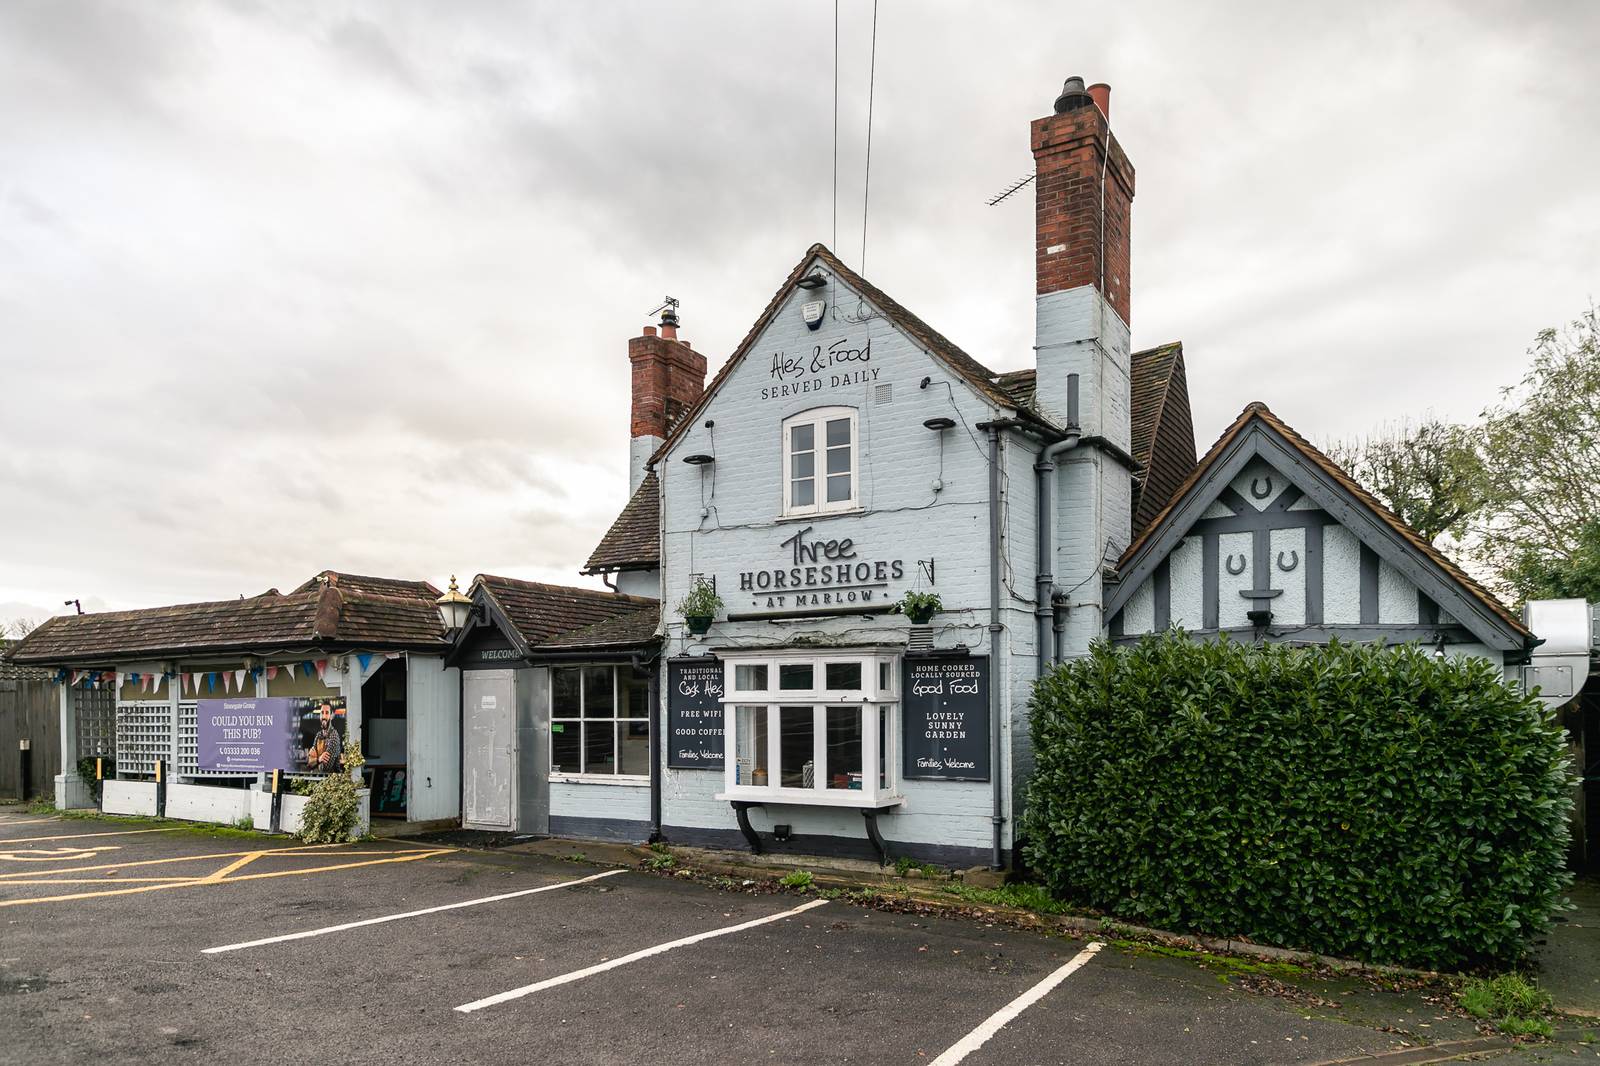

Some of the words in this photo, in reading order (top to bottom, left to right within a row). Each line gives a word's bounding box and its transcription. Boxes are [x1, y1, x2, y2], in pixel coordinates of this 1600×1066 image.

[771, 352, 804, 380] Ales
[810, 346, 825, 372] &
[828, 339, 870, 366] Food
[762, 379, 822, 400] SERVED
[831, 368, 880, 387] DAILY
[781, 526, 856, 565] Three
[740, 560, 904, 590] HORSESHOES
[767, 597, 785, 608] AT
[796, 590, 873, 606] MARLOW
[482, 650, 519, 659] WELCOME
[679, 681, 699, 697] Cask
[704, 680, 723, 697] Ales
[913, 680, 942, 696] Good
[949, 679, 978, 695] Food
[212, 716, 237, 726] COULD
[239, 716, 255, 726] YOU
[257, 716, 273, 725] RUN
[223, 729, 241, 738] THIS
[243, 729, 261, 738] PUB?
[679, 749, 699, 760] Families
[700, 750, 724, 759] Welcome
[917, 758, 942, 770] Families
[944, 758, 975, 768] Welcome
